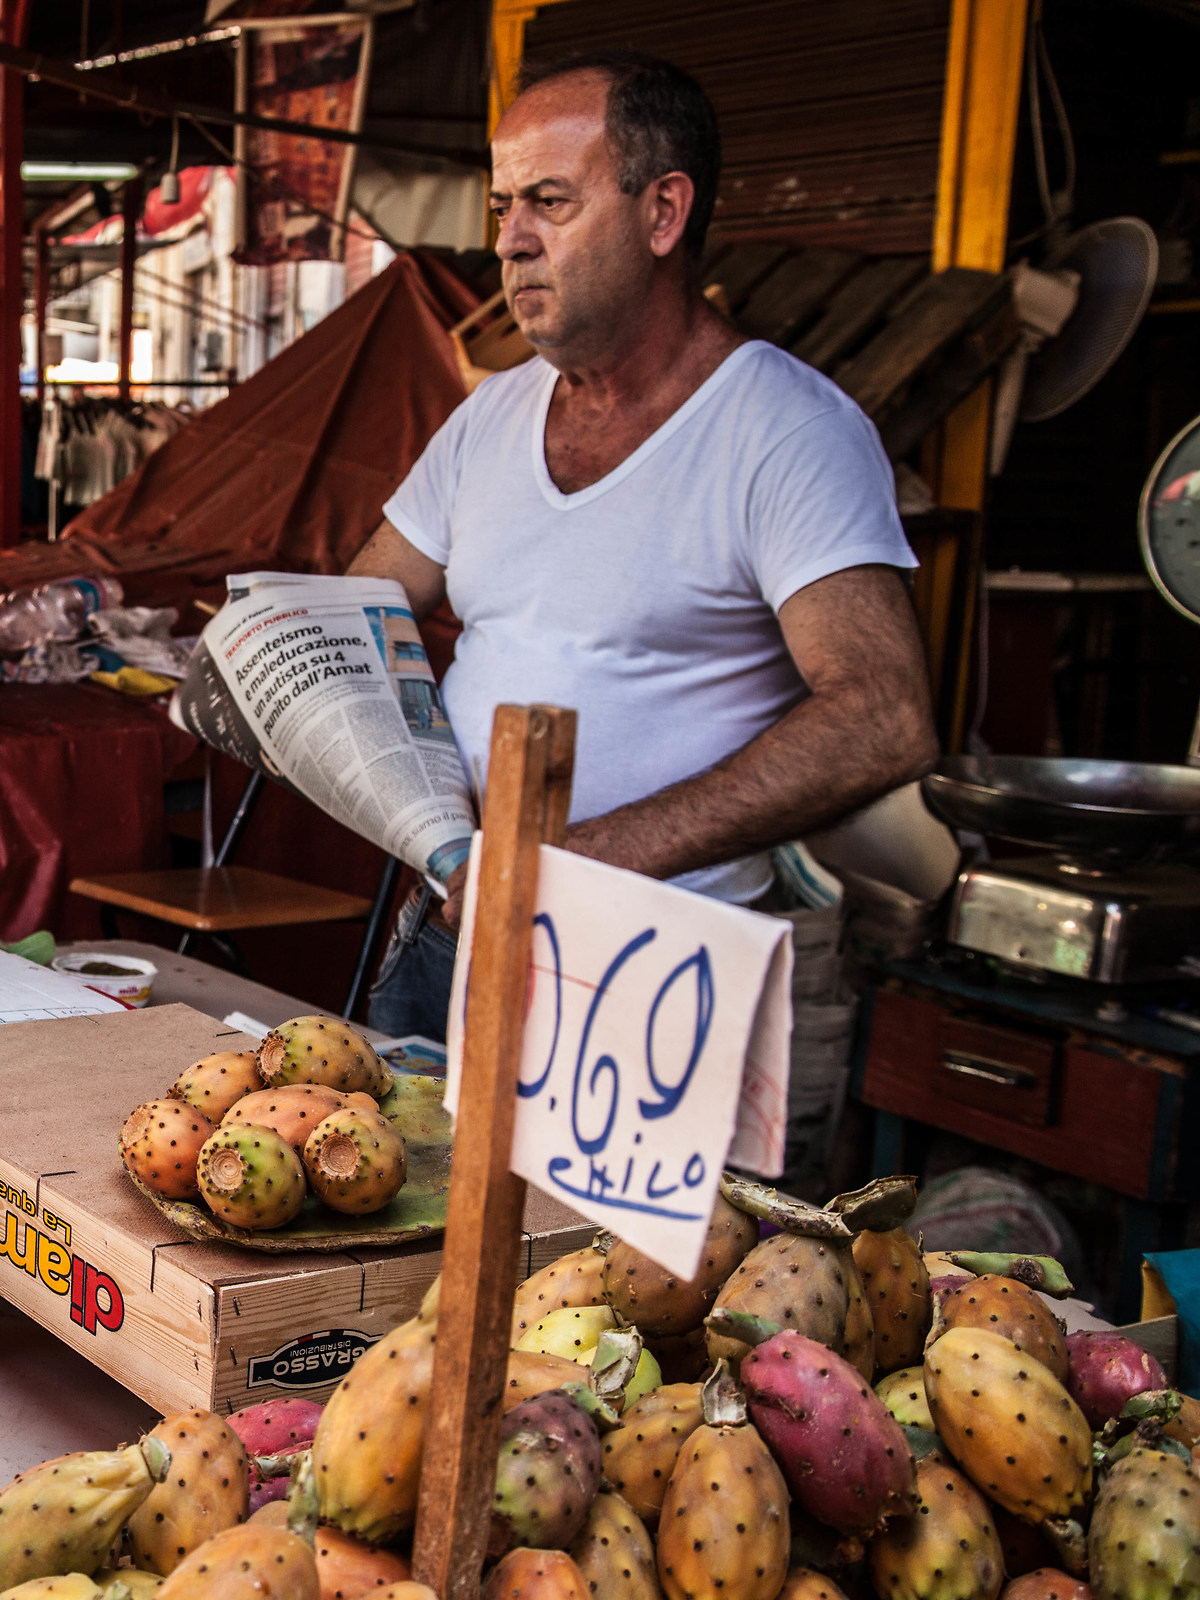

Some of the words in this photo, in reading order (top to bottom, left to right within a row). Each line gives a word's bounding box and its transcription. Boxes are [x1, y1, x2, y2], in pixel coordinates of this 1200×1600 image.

[264, 608, 309, 627] PUBBLICO
[235, 625, 323, 685] Assenteismo
[245, 690, 253, 702] e
[250, 637, 368, 697] maleducazione,
[254, 701, 266, 719] un
[264, 661, 309, 702] autista
[311, 652, 331, 669] su
[334, 651, 346, 663] 4
[263, 693, 292, 739] punito
[292, 662, 373, 699] dall'Amat
[42, 1207, 73, 1246] La
[273, 1346, 367, 1377] GRASSO
[289, 1339, 352, 1358] DISTRIBUZIONI
